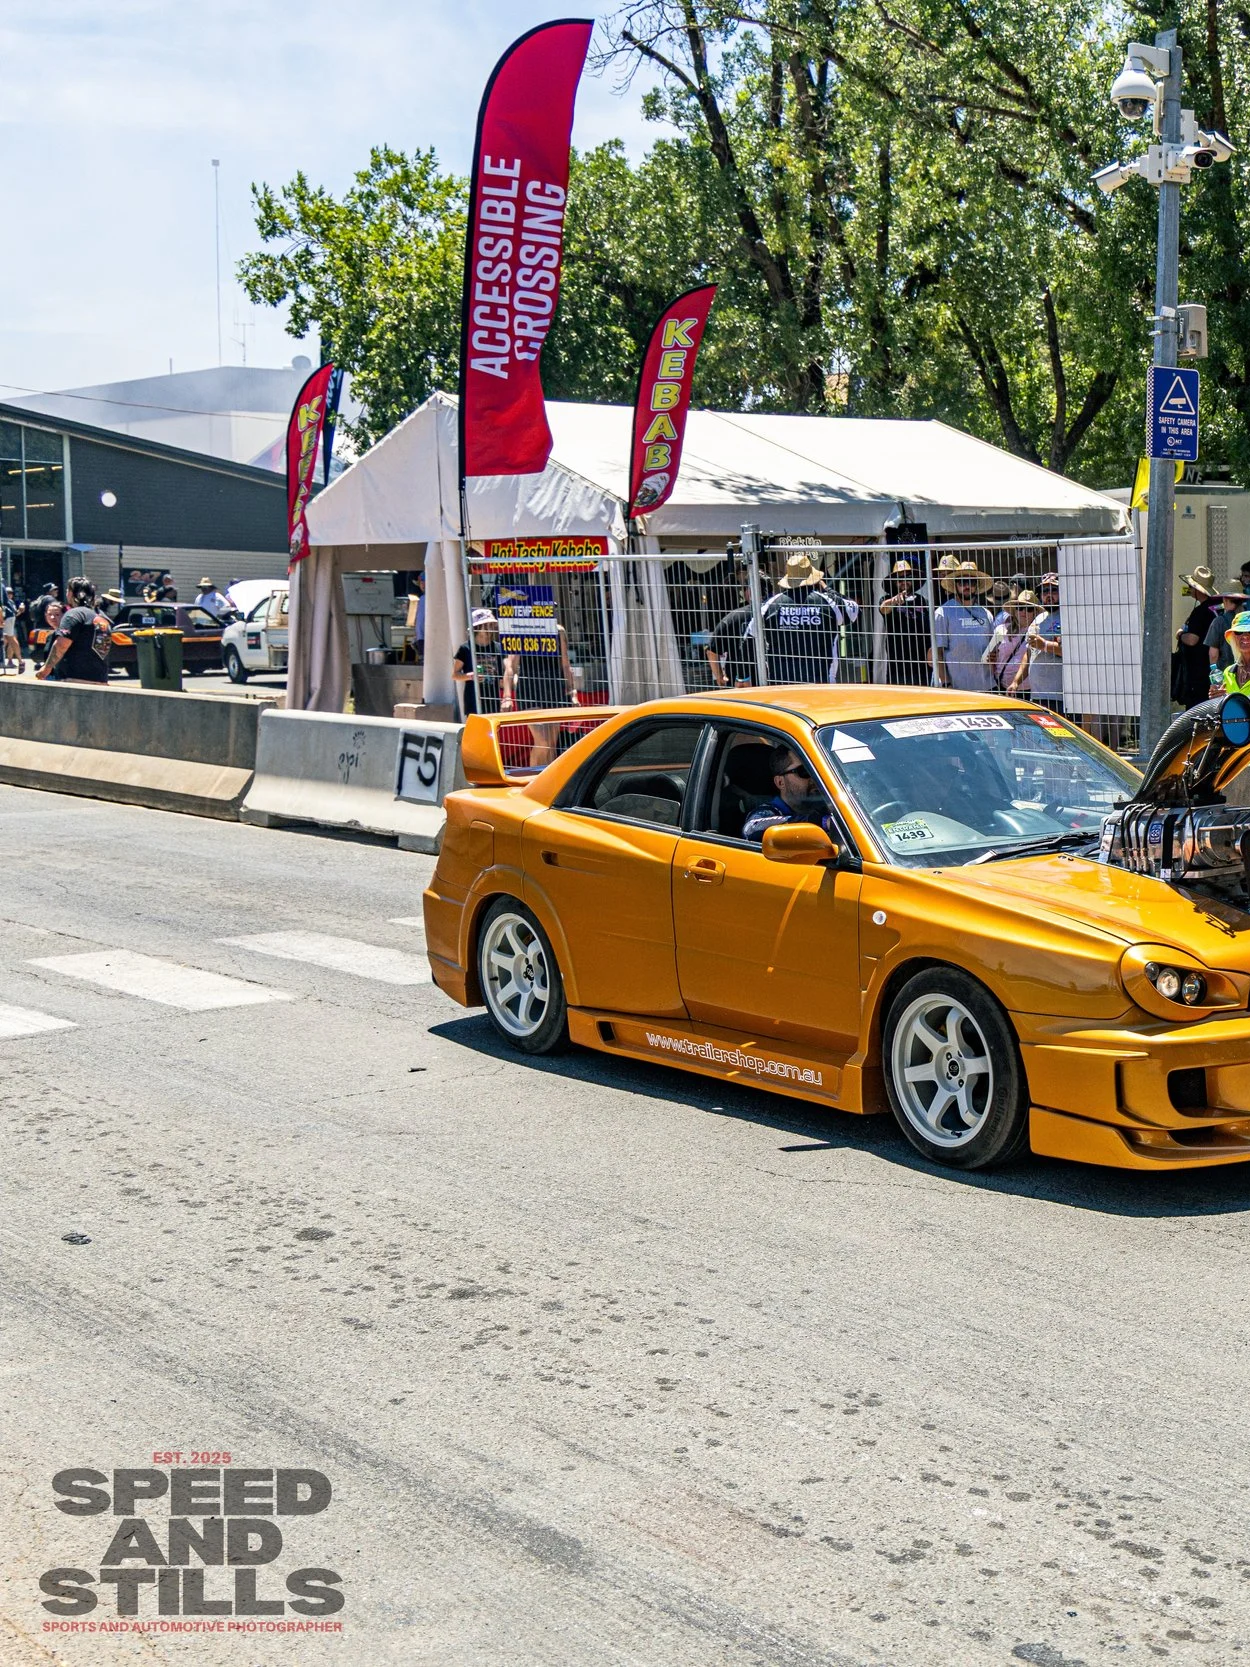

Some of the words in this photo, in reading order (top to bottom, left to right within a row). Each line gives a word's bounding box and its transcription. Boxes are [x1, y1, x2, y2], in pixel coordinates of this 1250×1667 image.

[470, 155, 521, 379] ACCESSIBLE
[512, 181, 567, 361] CROSSING
[642, 318, 698, 472] KEBAB
[1158, 416, 1175, 425] SAFETY
[1177, 418, 1196, 427] CAMERA
[1168, 427, 1179, 435] THIS
[1180, 428, 1193, 436] AREA
[490, 542, 513, 568] Hot
[515, 541, 550, 572] Tasty
[550, 538, 602, 567] Kebabs
[780, 606, 821, 616] SECURITY
[779, 616, 821, 626] NSRG
[501, 637, 521, 651] 1300
[523, 637, 539, 652] 836
[541, 637, 557, 652] 733
[956, 714, 1004, 728] 1439
[397, 733, 443, 795] F5
[895, 830, 926, 841] 1439
[645, 1032, 823, 1085] www.trailershop.com.au
